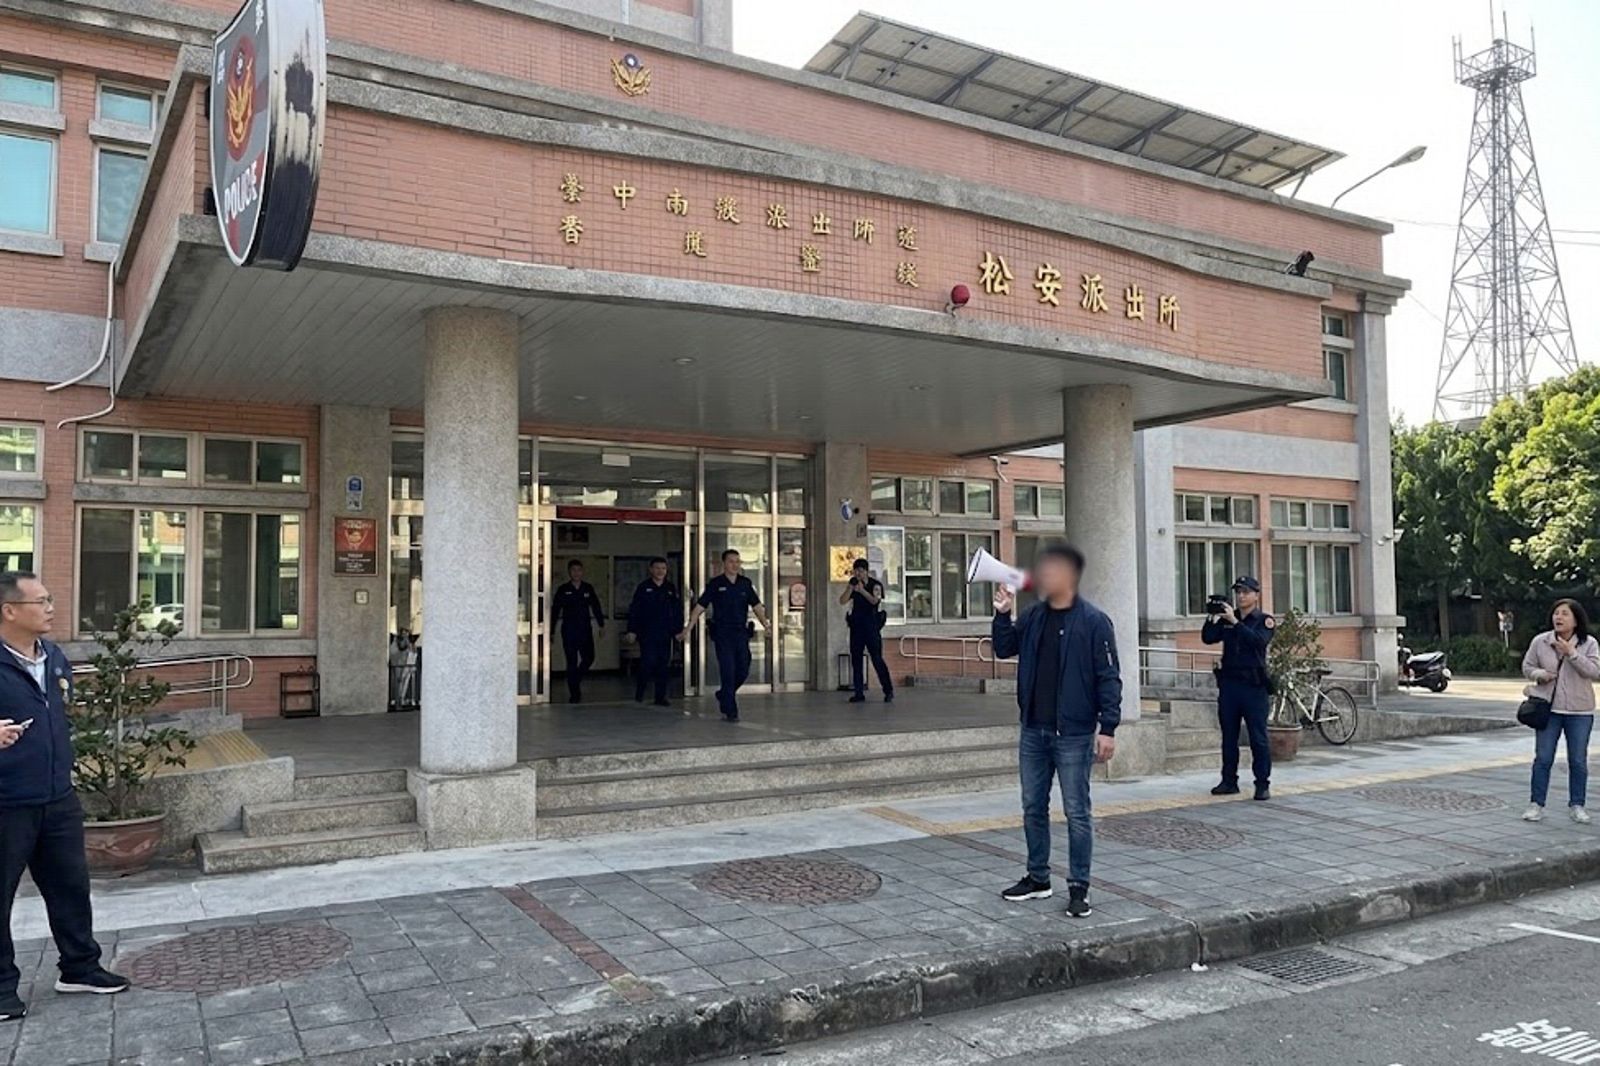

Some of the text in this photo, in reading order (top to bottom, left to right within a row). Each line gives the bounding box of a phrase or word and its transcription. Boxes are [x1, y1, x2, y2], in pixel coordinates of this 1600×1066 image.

[224, 160, 258, 224] POLICE
[978, 250, 1181, 331] 松安派出所
